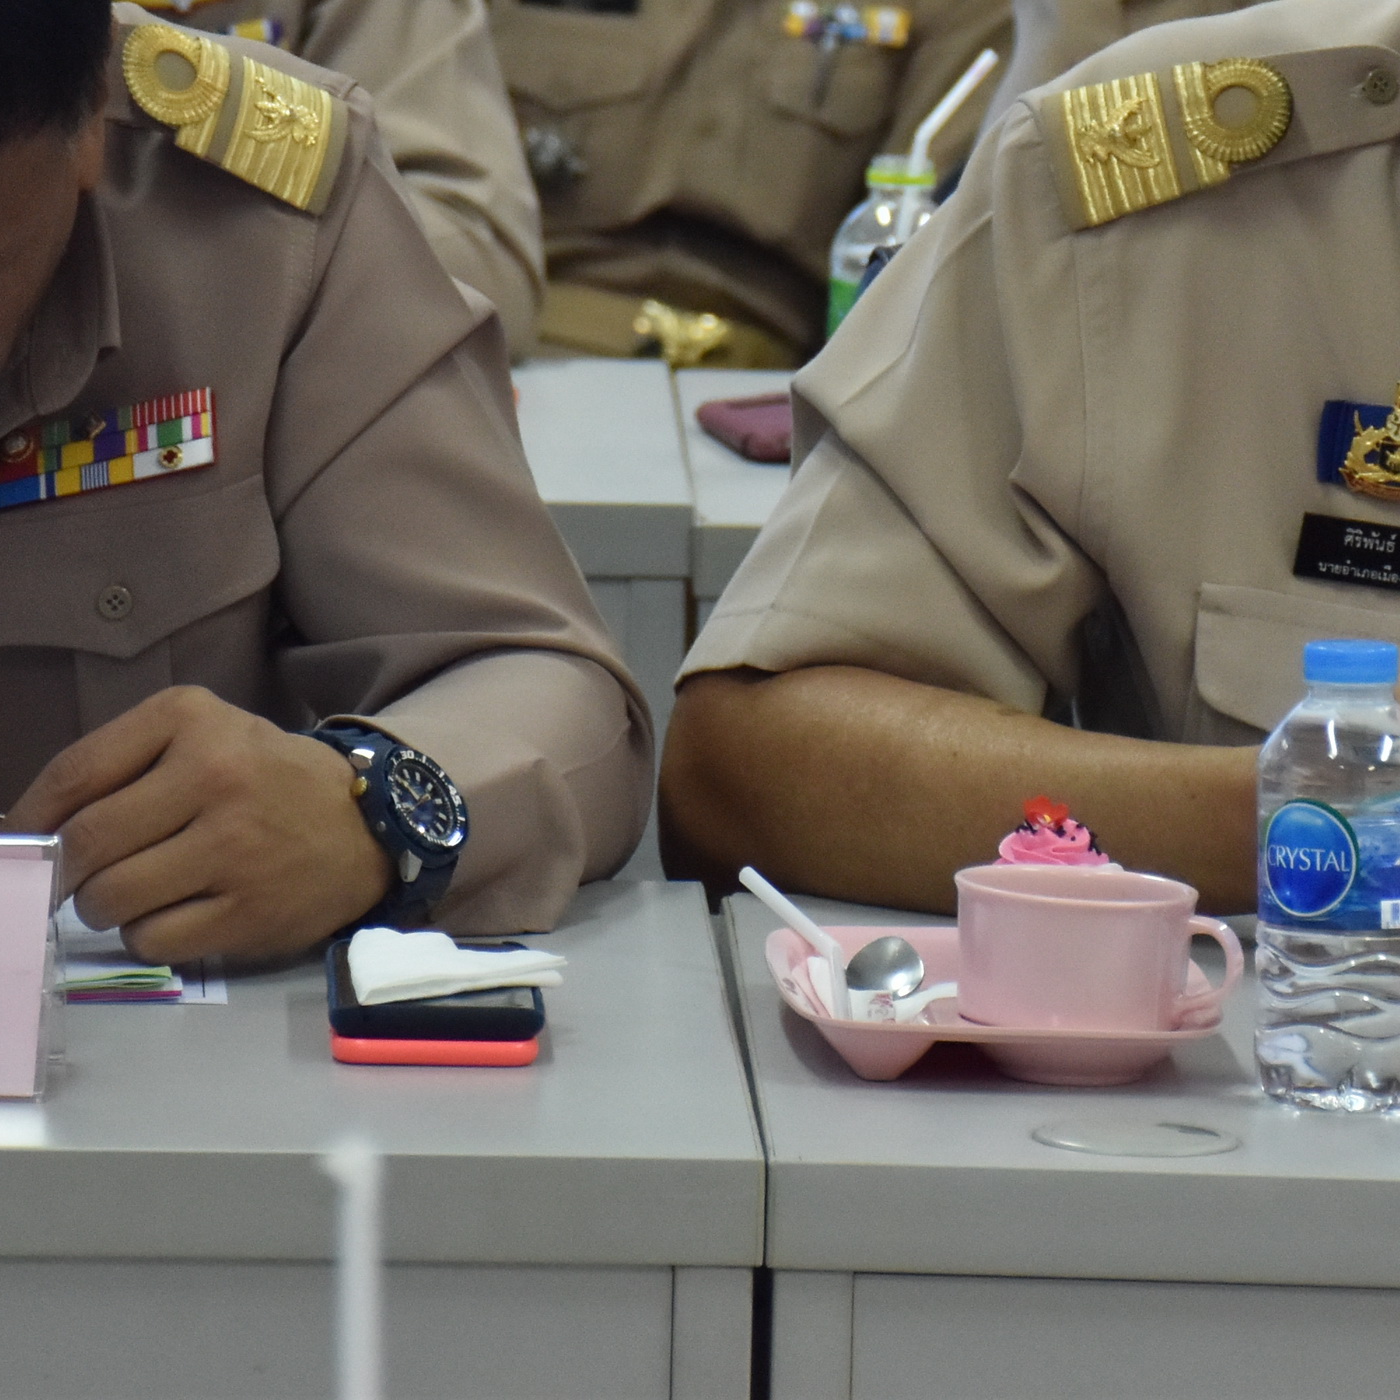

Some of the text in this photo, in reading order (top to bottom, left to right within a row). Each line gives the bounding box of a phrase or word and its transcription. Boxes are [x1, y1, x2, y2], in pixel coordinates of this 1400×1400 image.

[1343, 527, 1397, 554] ศิริพันธ์
[400, 750, 415, 760] 30
[1267, 844, 1350, 872] CRYSTAL
